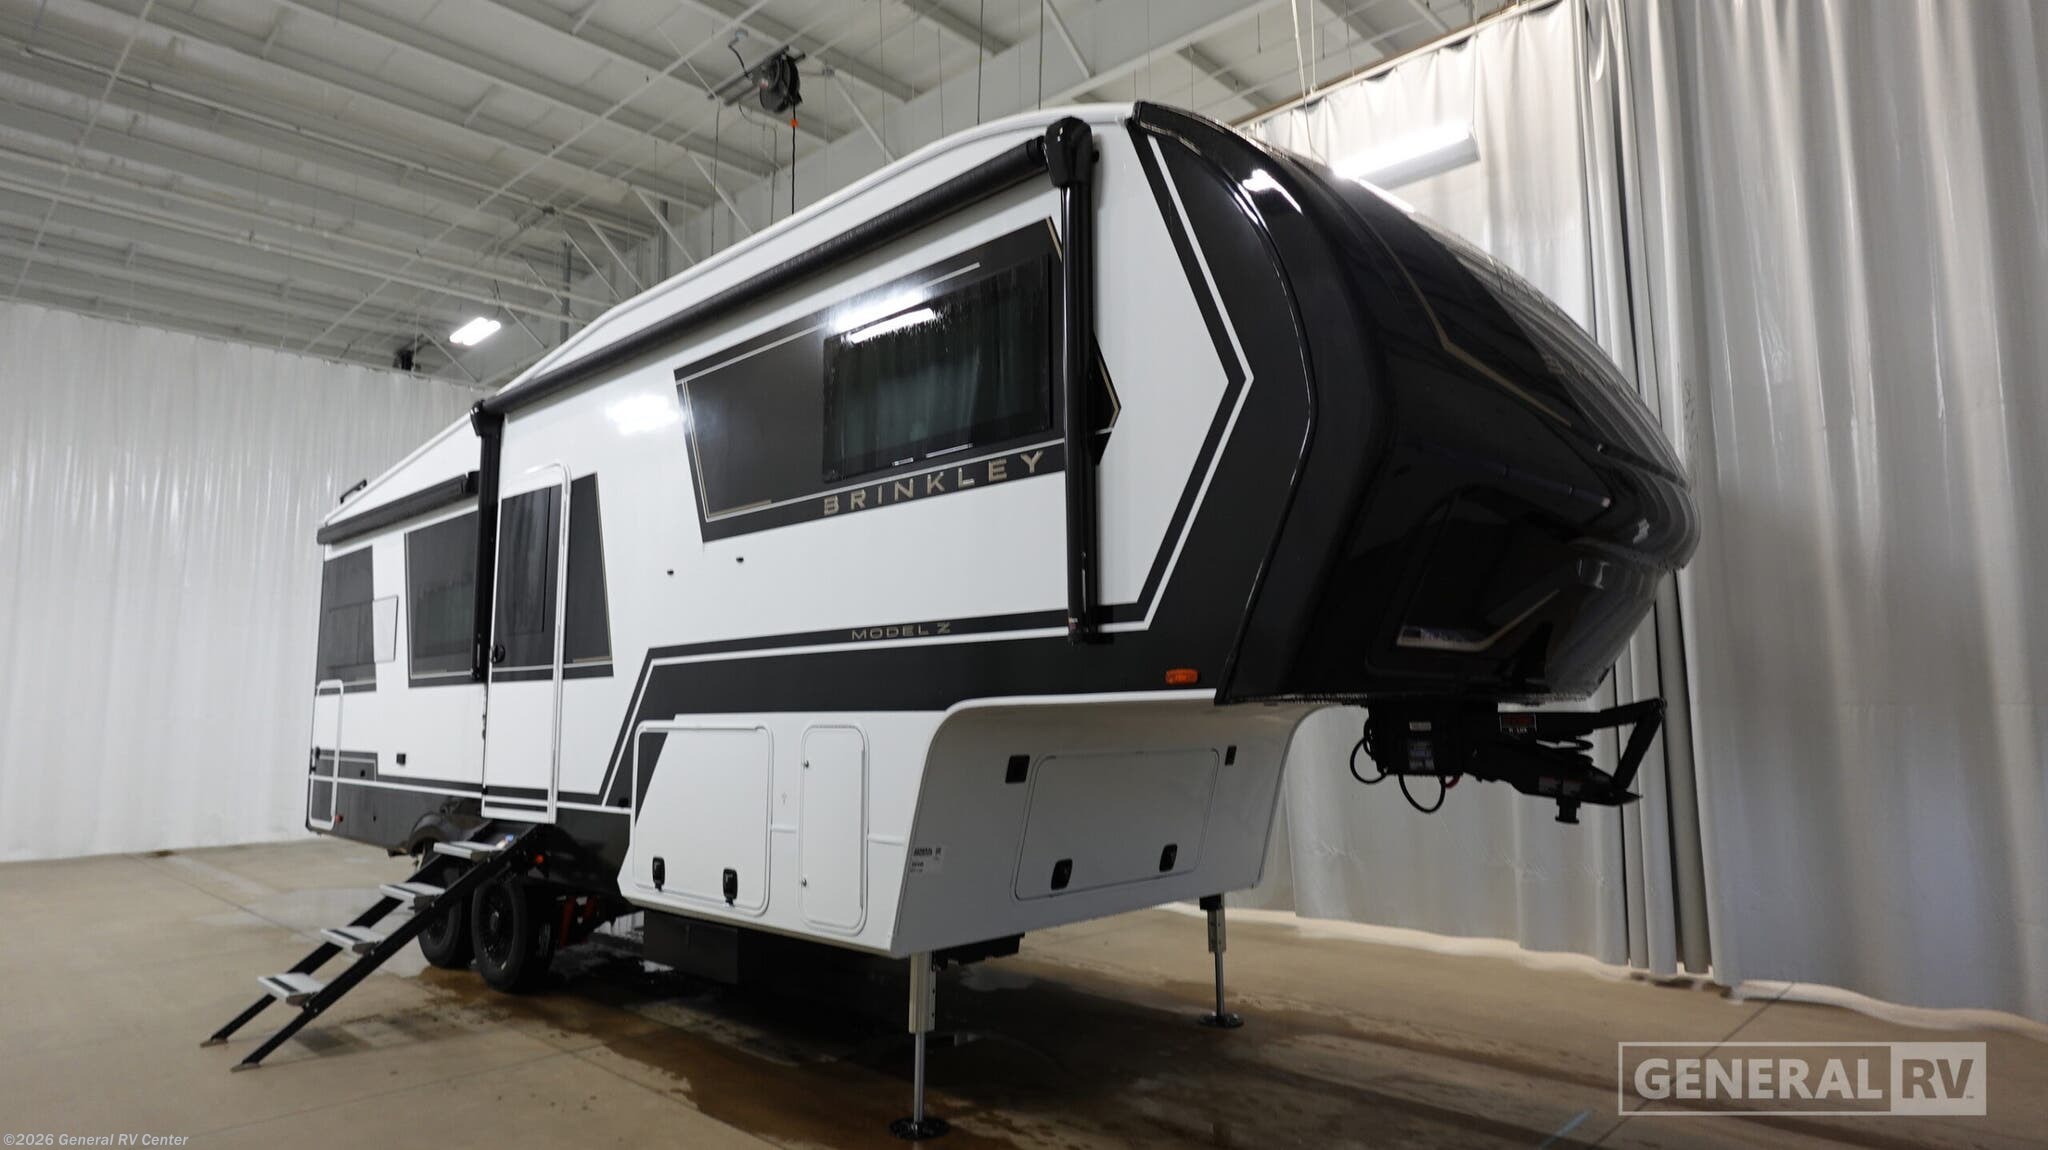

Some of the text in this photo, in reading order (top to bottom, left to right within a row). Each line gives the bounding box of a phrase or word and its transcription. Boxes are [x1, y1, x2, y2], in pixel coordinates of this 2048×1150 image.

[824, 451, 1043, 515] BRINKLEY
[851, 622, 951, 640] MODEL Z
